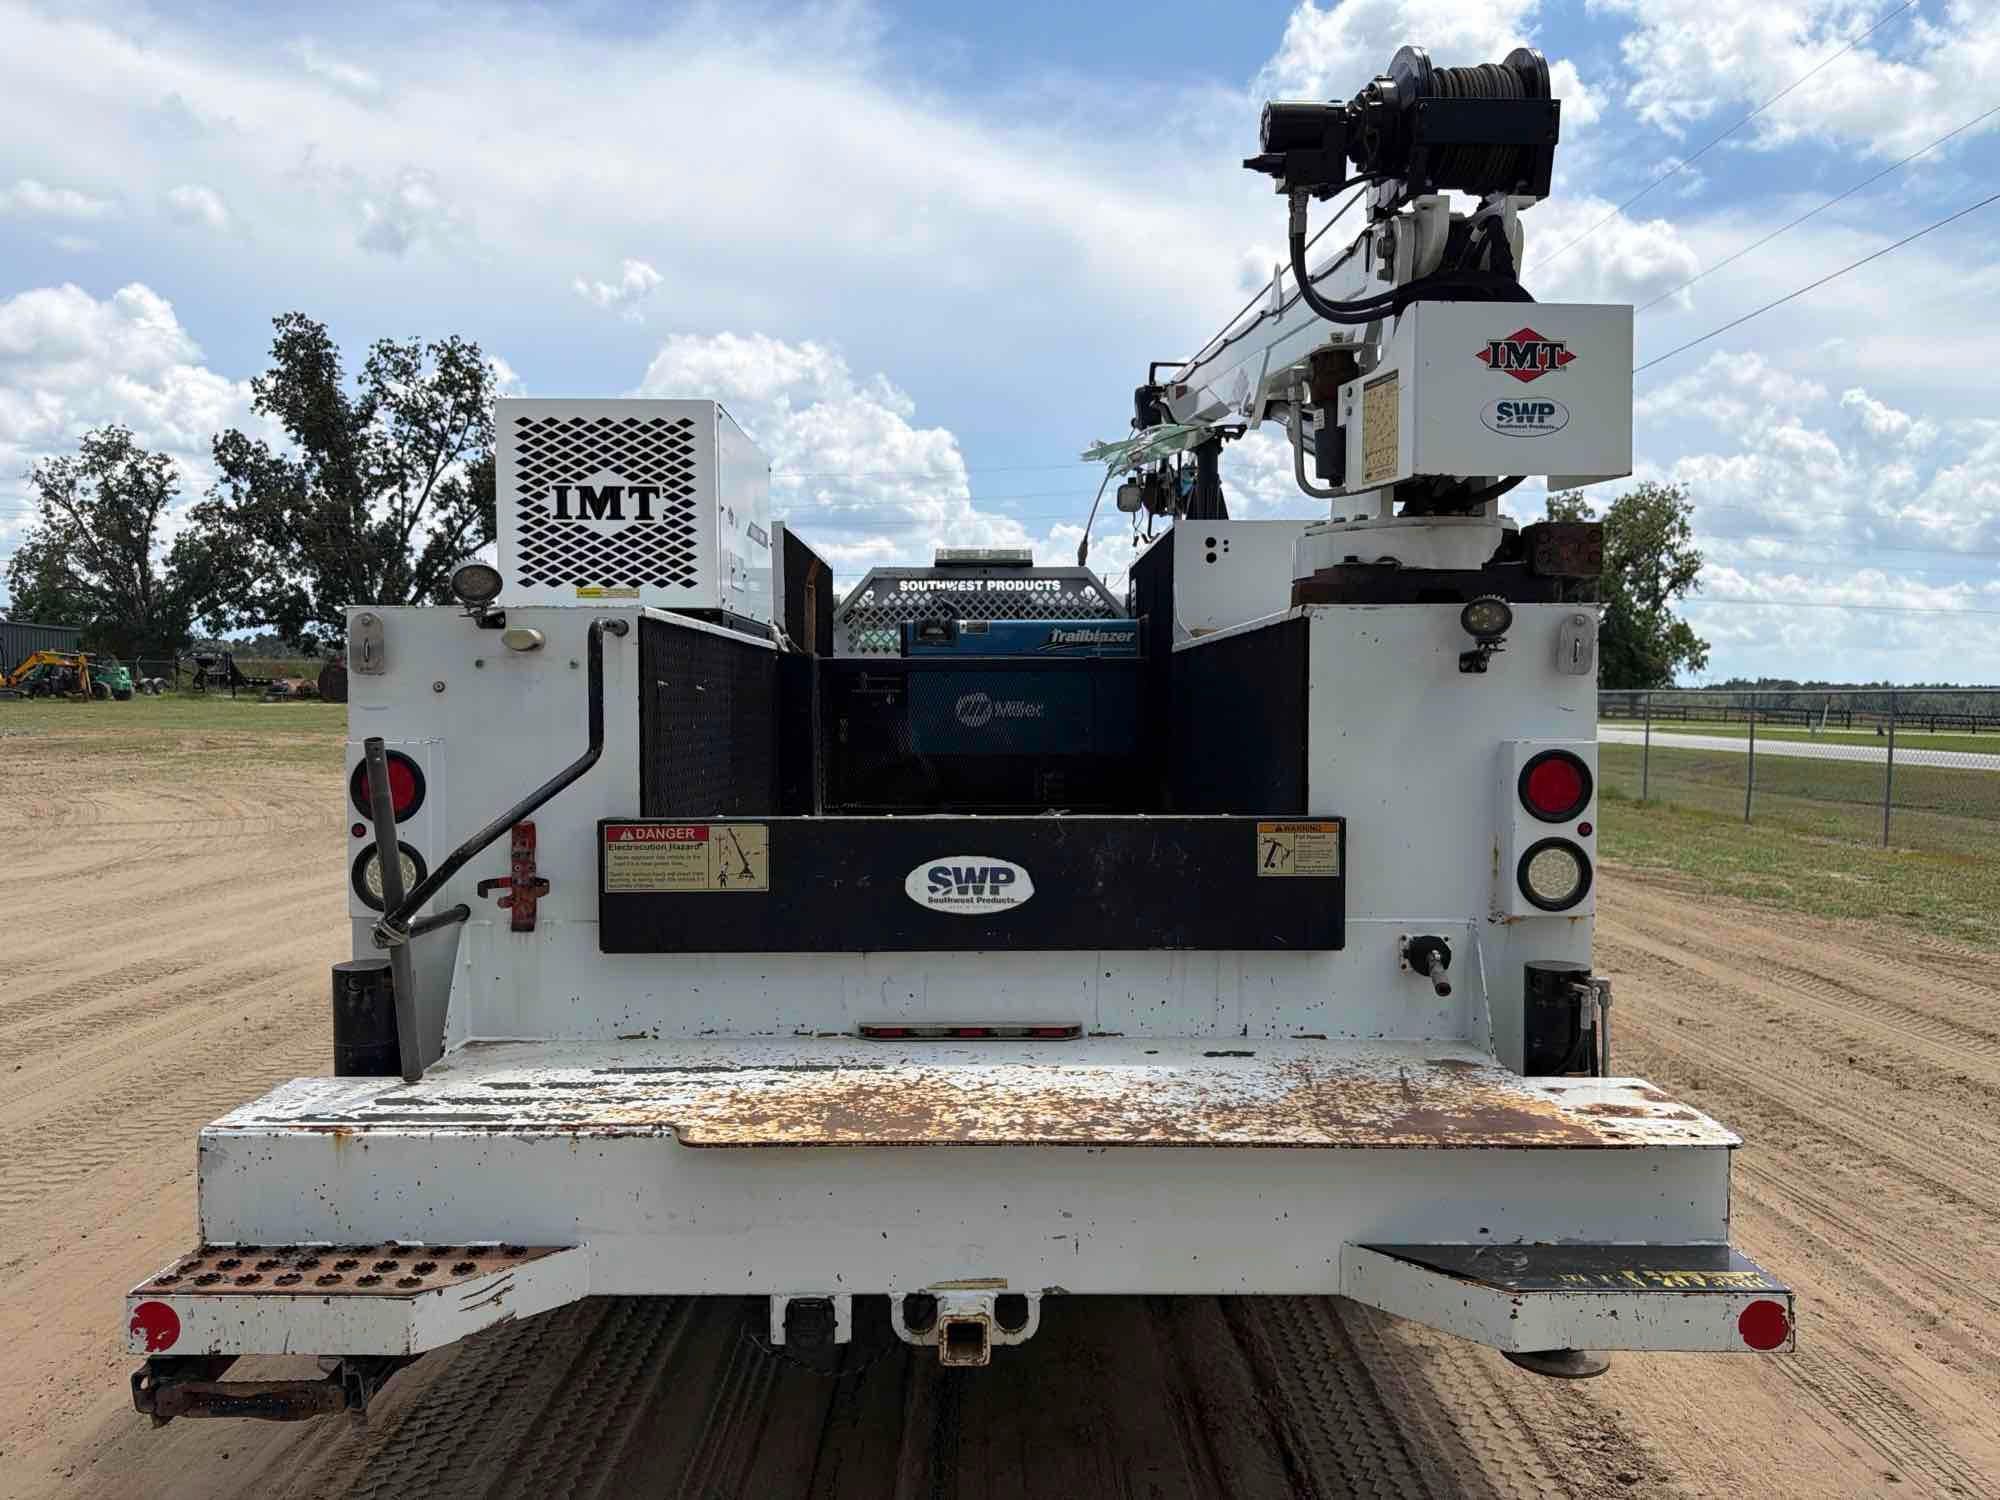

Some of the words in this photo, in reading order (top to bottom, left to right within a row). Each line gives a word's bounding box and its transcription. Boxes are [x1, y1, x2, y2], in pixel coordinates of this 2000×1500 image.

[1488, 341, 1564, 369] IMT
[1496, 401, 1555, 423] SWP
[551, 485, 661, 521] IMT
[899, 580, 984, 592] SOUTHWEST
[986, 580, 1061, 592] PRODUCTS
[1050, 628, 1136, 642] Trailblazer
[635, 827, 696, 840] DANGER
[1283, 824, 1322, 833] WARNING
[927, 866, 1016, 895] SWP
[927, 896, 974, 904] Southwest
